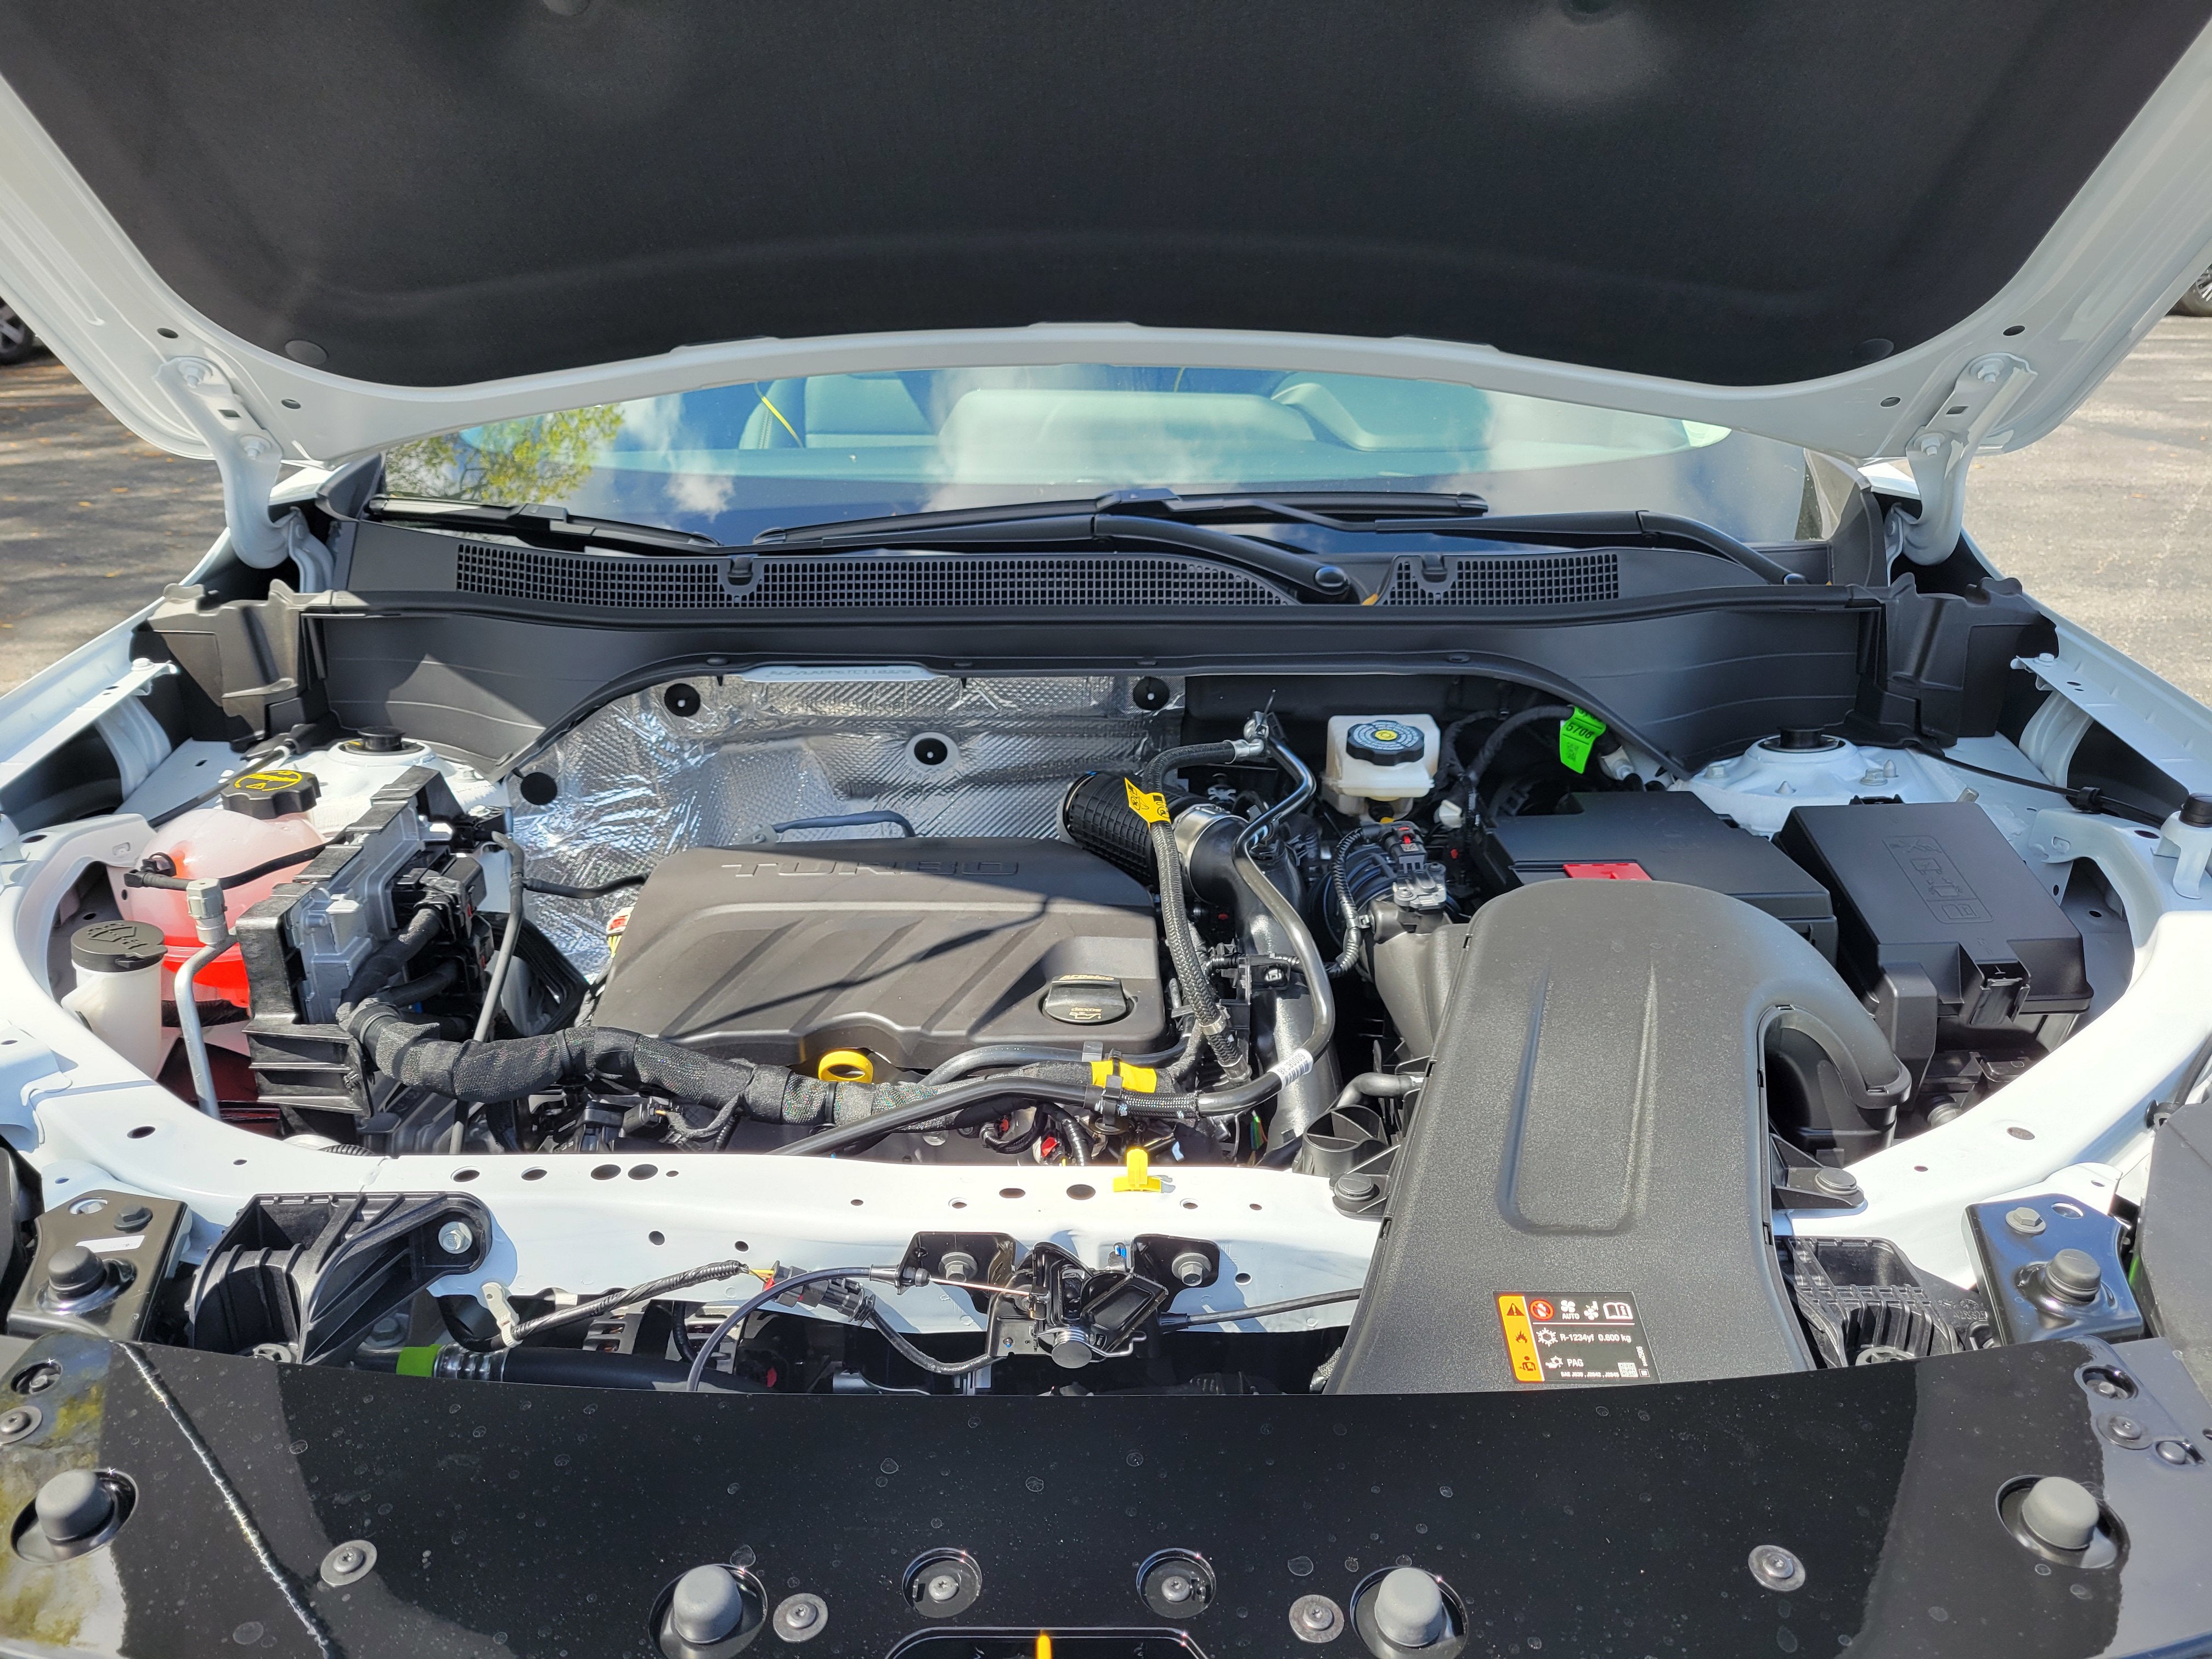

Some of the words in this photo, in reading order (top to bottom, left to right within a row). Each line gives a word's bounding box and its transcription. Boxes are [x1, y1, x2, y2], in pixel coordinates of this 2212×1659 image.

[1566, 721, 1595, 739] 5706
[721, 862, 1019, 877] TURBO
[1560, 1333, 1594, 1343] R-1234yf
[1620, 1334, 1632, 1343] kg
[1566, 1358, 1584, 1367] PAG
